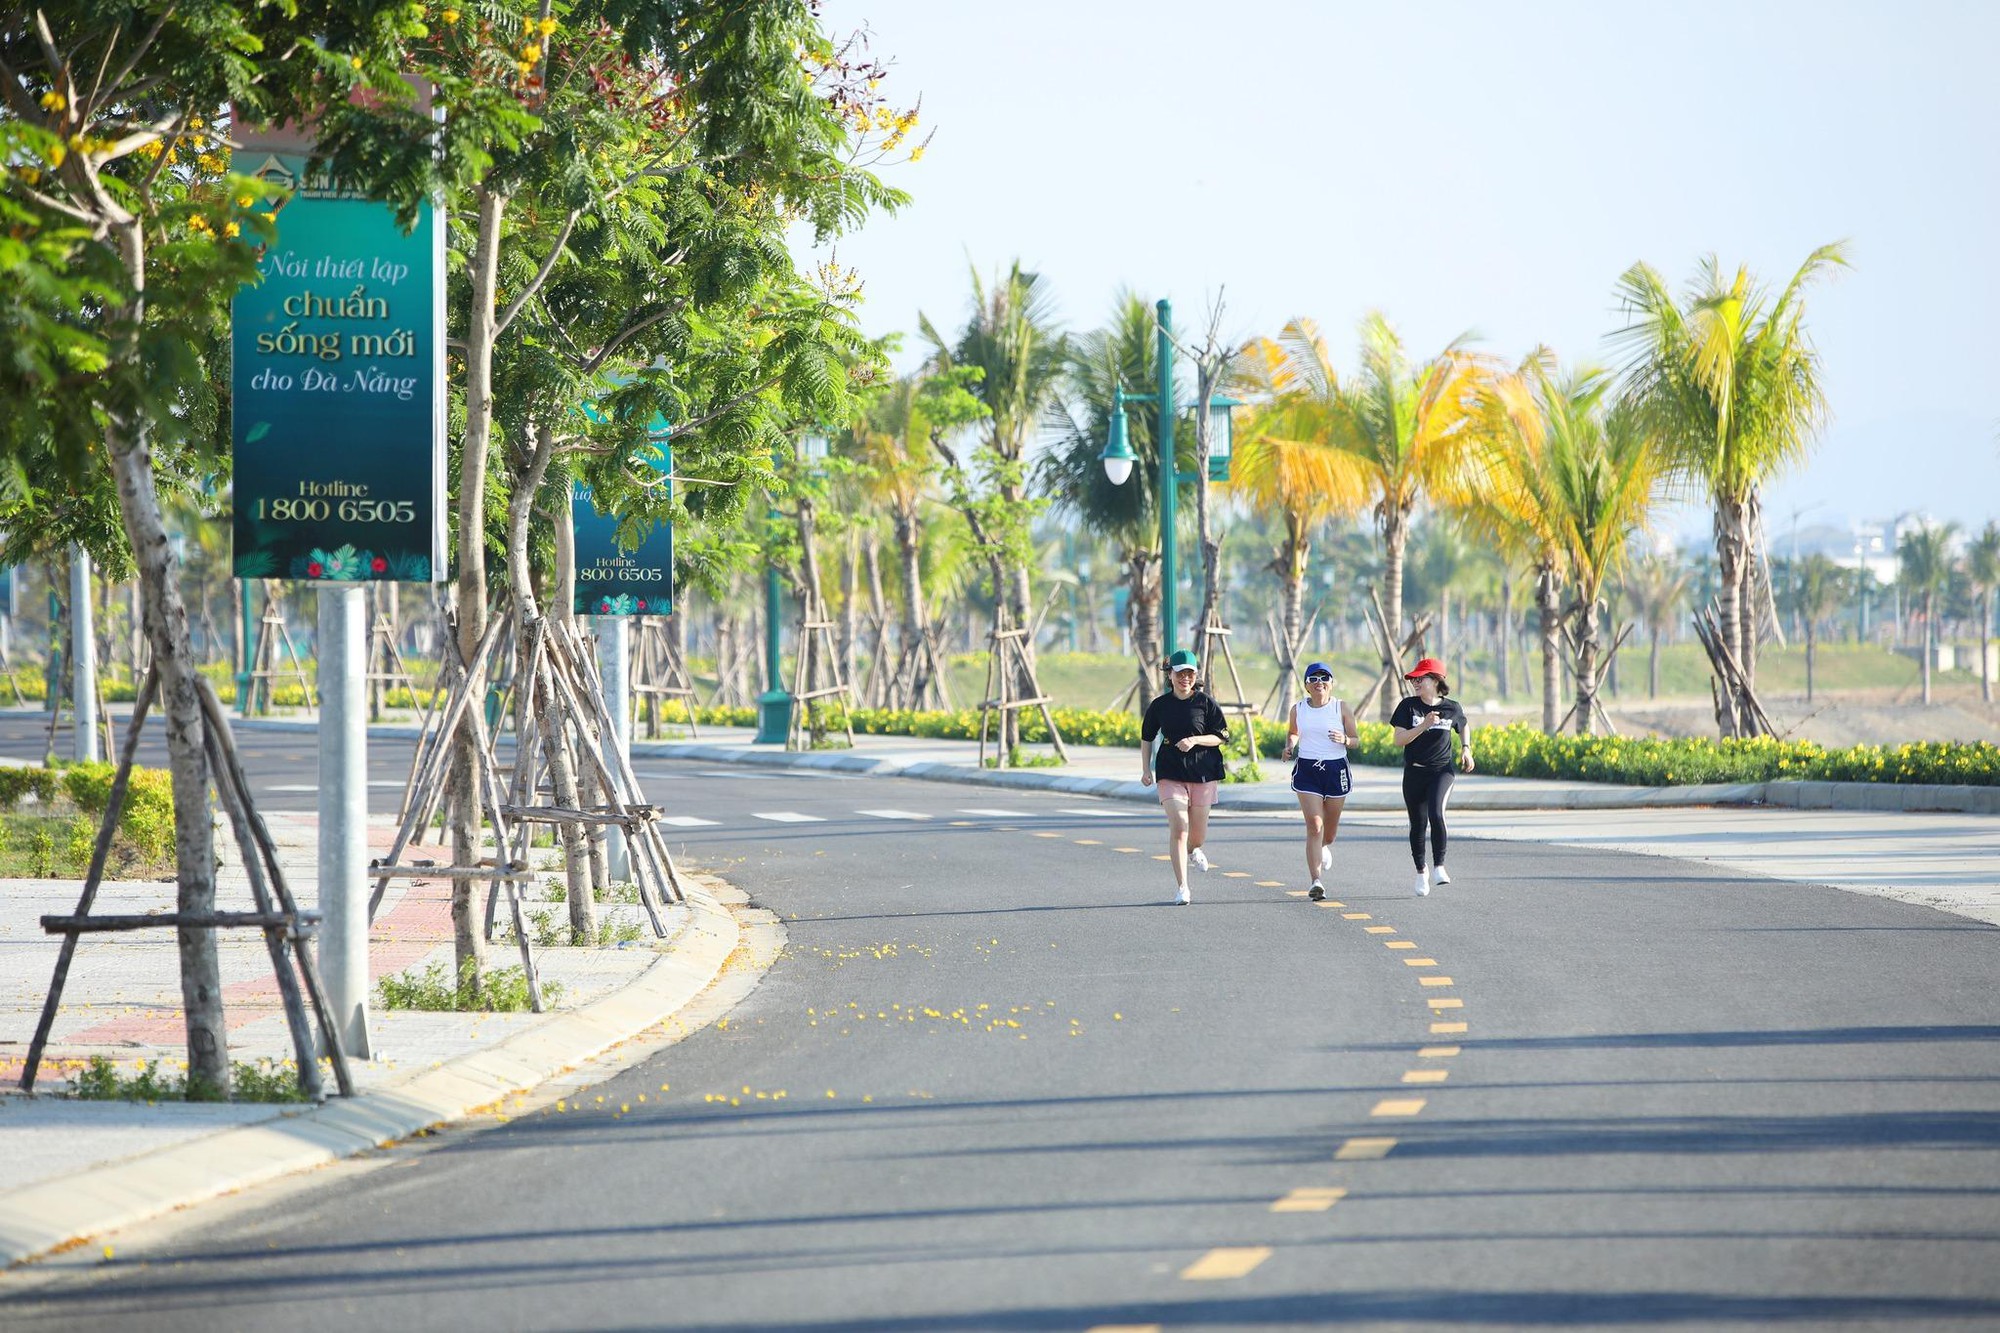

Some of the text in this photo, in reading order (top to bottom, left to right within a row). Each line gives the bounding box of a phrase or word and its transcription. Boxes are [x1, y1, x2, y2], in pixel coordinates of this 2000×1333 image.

[260, 251, 408, 286] Nơi thiết lập
[283, 284, 388, 318] chuẩn
[256, 321, 415, 361] sống mới
[251, 366, 417, 400] cho Đà Nẵng
[299, 480, 368, 497] Hotline
[257, 498, 416, 523] 1800 6505
[596, 557, 636, 567] Hotline
[618, 567, 662, 581] 6505
